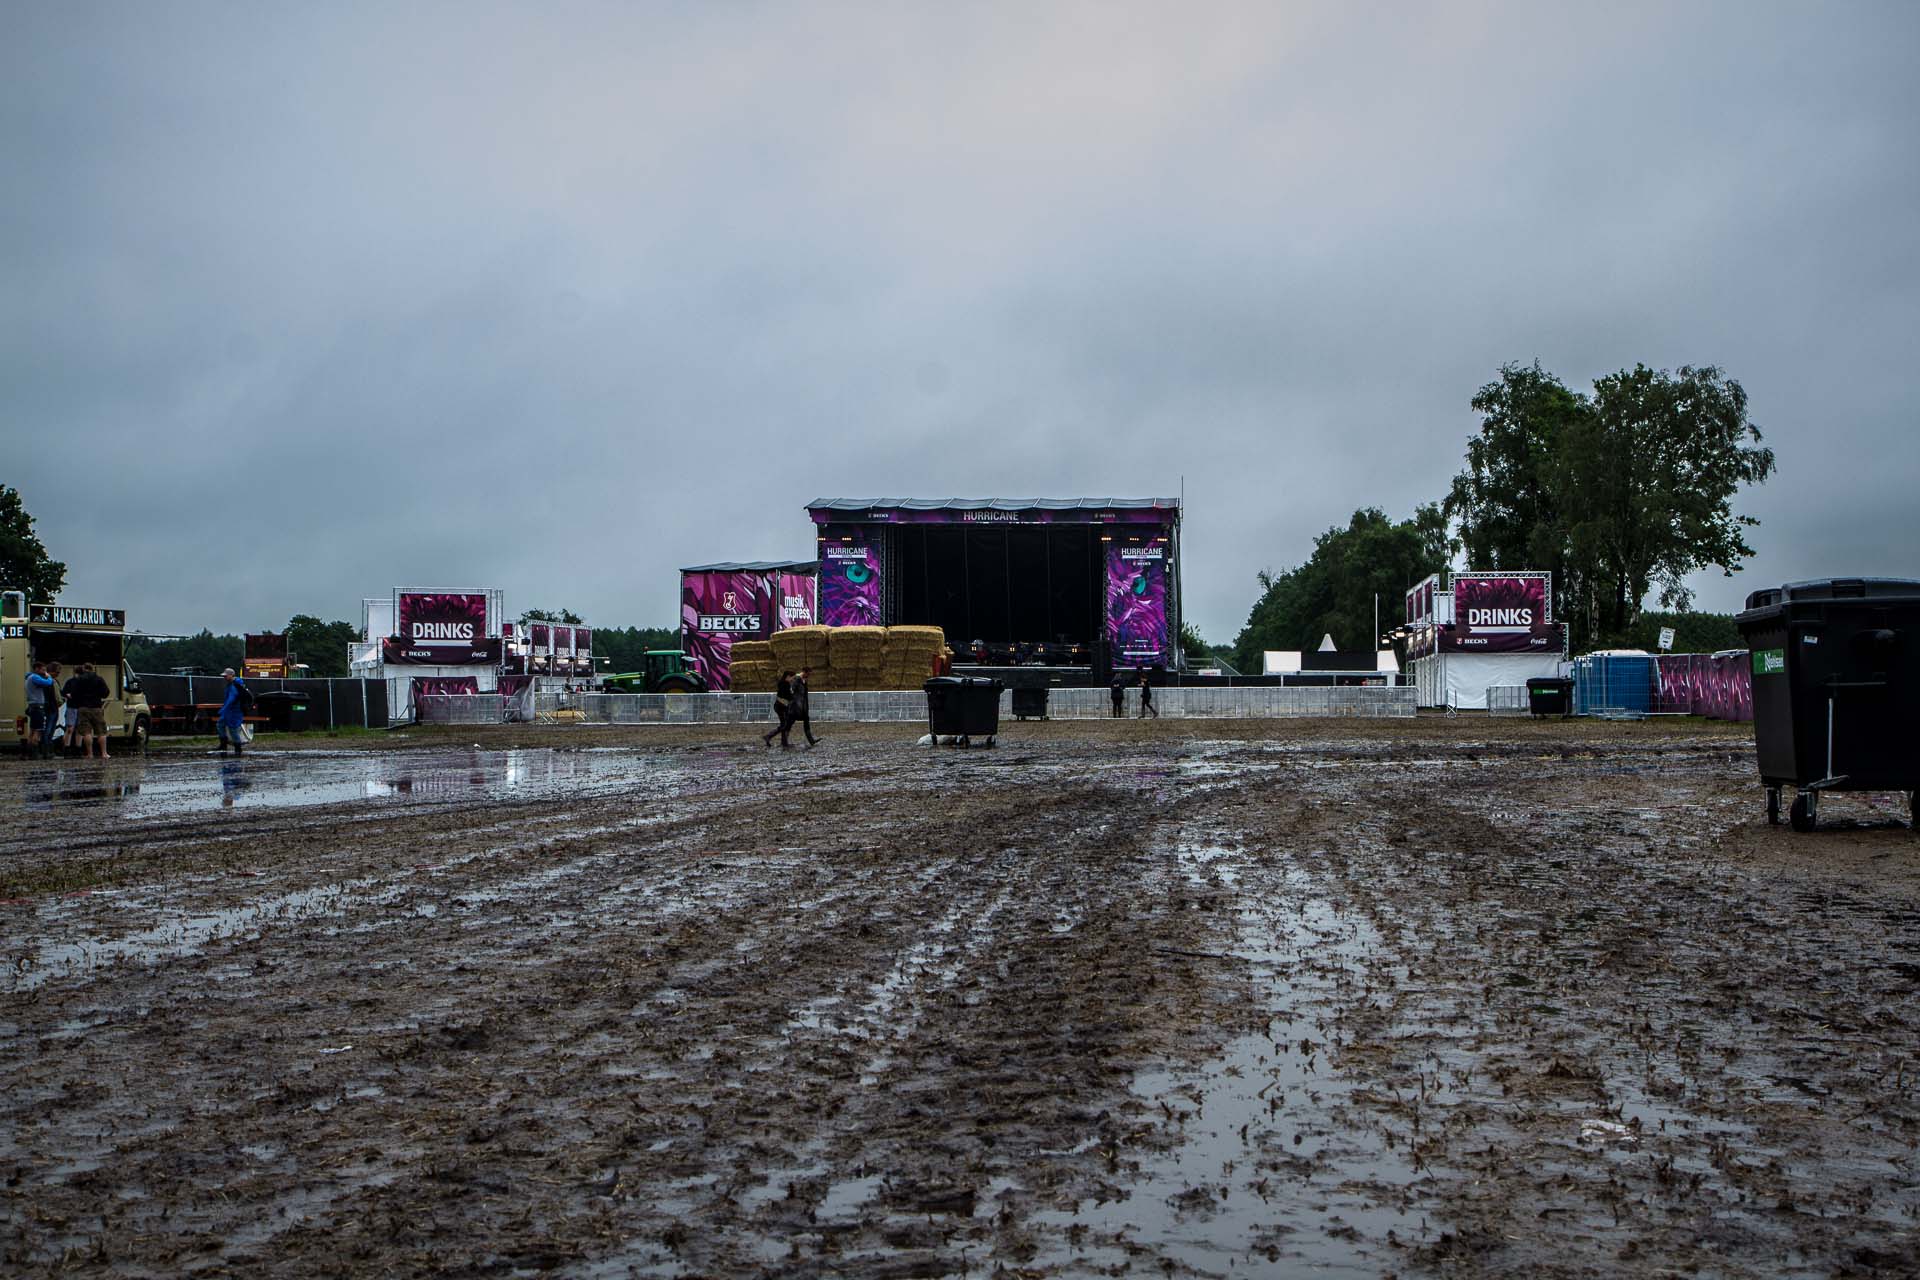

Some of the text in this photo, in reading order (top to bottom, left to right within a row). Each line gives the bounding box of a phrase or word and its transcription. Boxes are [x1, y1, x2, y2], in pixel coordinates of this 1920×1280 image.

[963, 511, 1019, 521] HURRICANE
[827, 547, 868, 555] HURRICANE
[1121, 547, 1162, 555] HURRICANE
[784, 594, 804, 608] musik
[53, 608, 104, 624] HACKBARON
[784, 608, 810, 621] express
[1468, 608, 1532, 625] DRINKS
[699, 615, 760, 630] BECK'S
[412, 622, 474, 639] DRINKS
